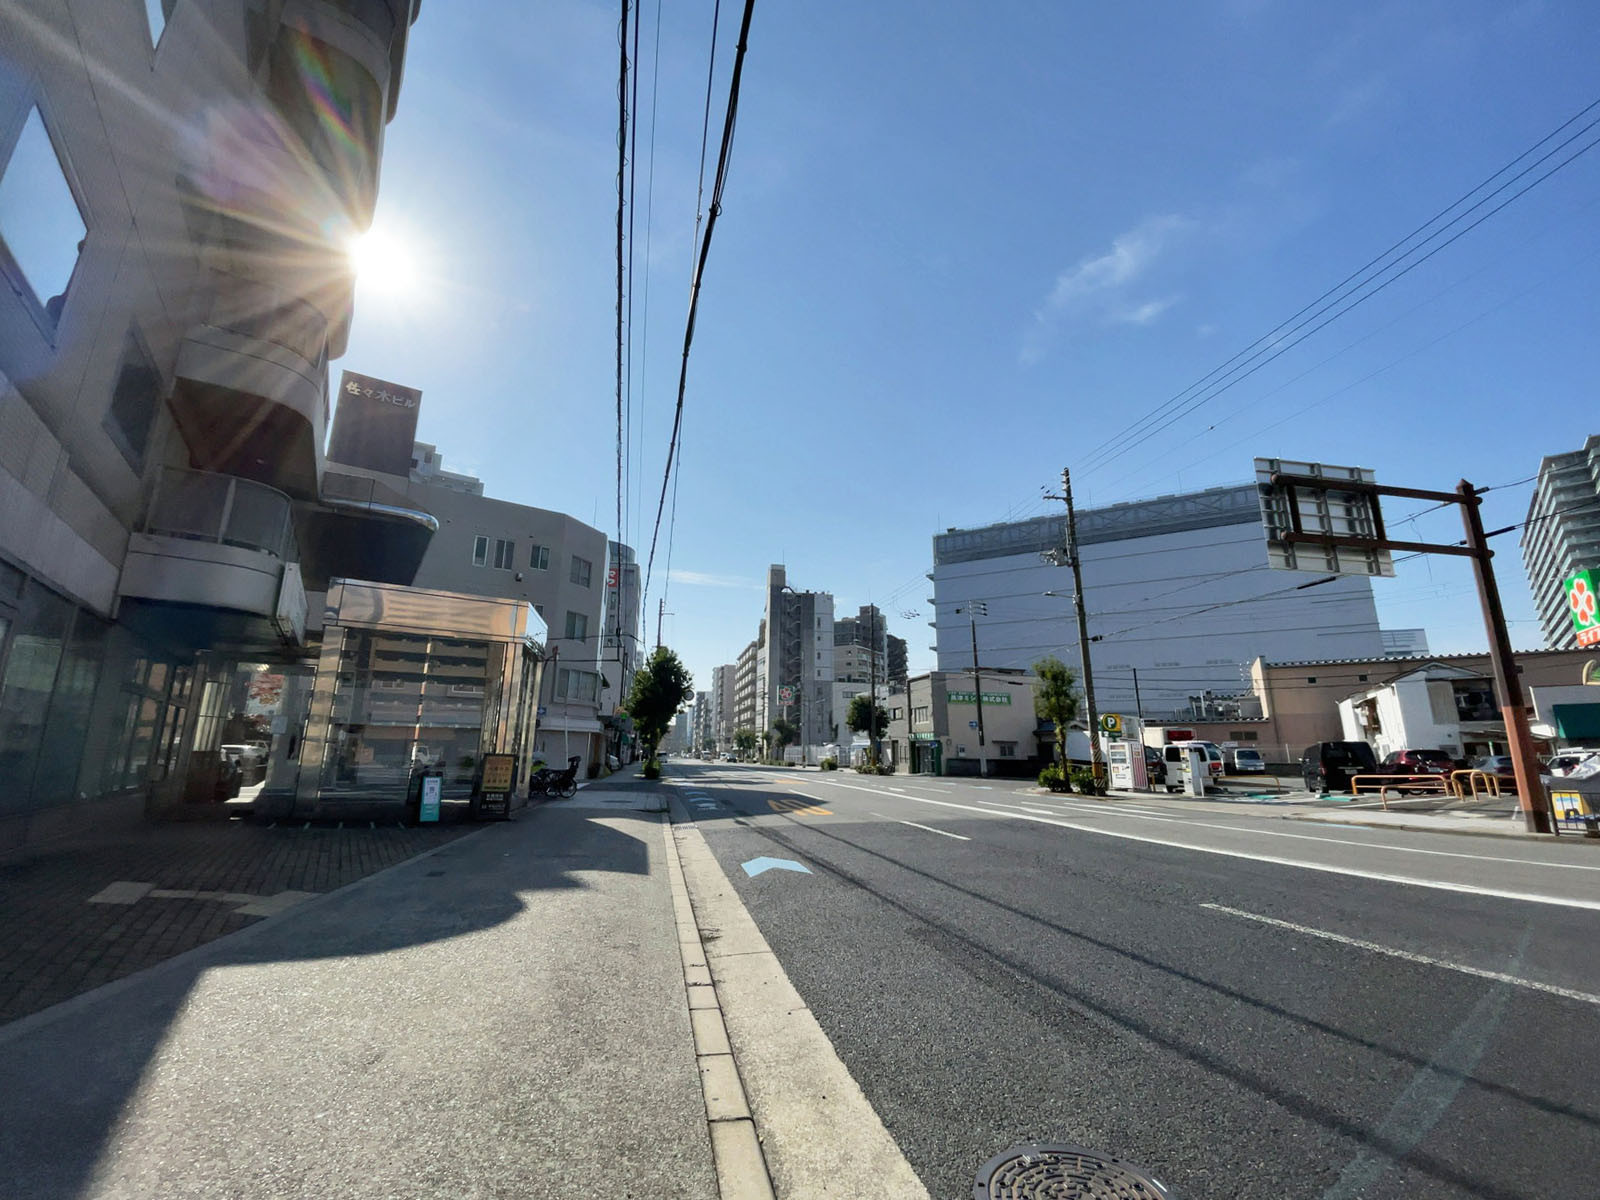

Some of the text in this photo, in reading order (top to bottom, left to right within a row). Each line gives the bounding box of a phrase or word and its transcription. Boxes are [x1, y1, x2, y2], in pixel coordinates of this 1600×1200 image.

[345, 381, 416, 408] 佐々木ビル
[1107, 717, 1116, 728] P
